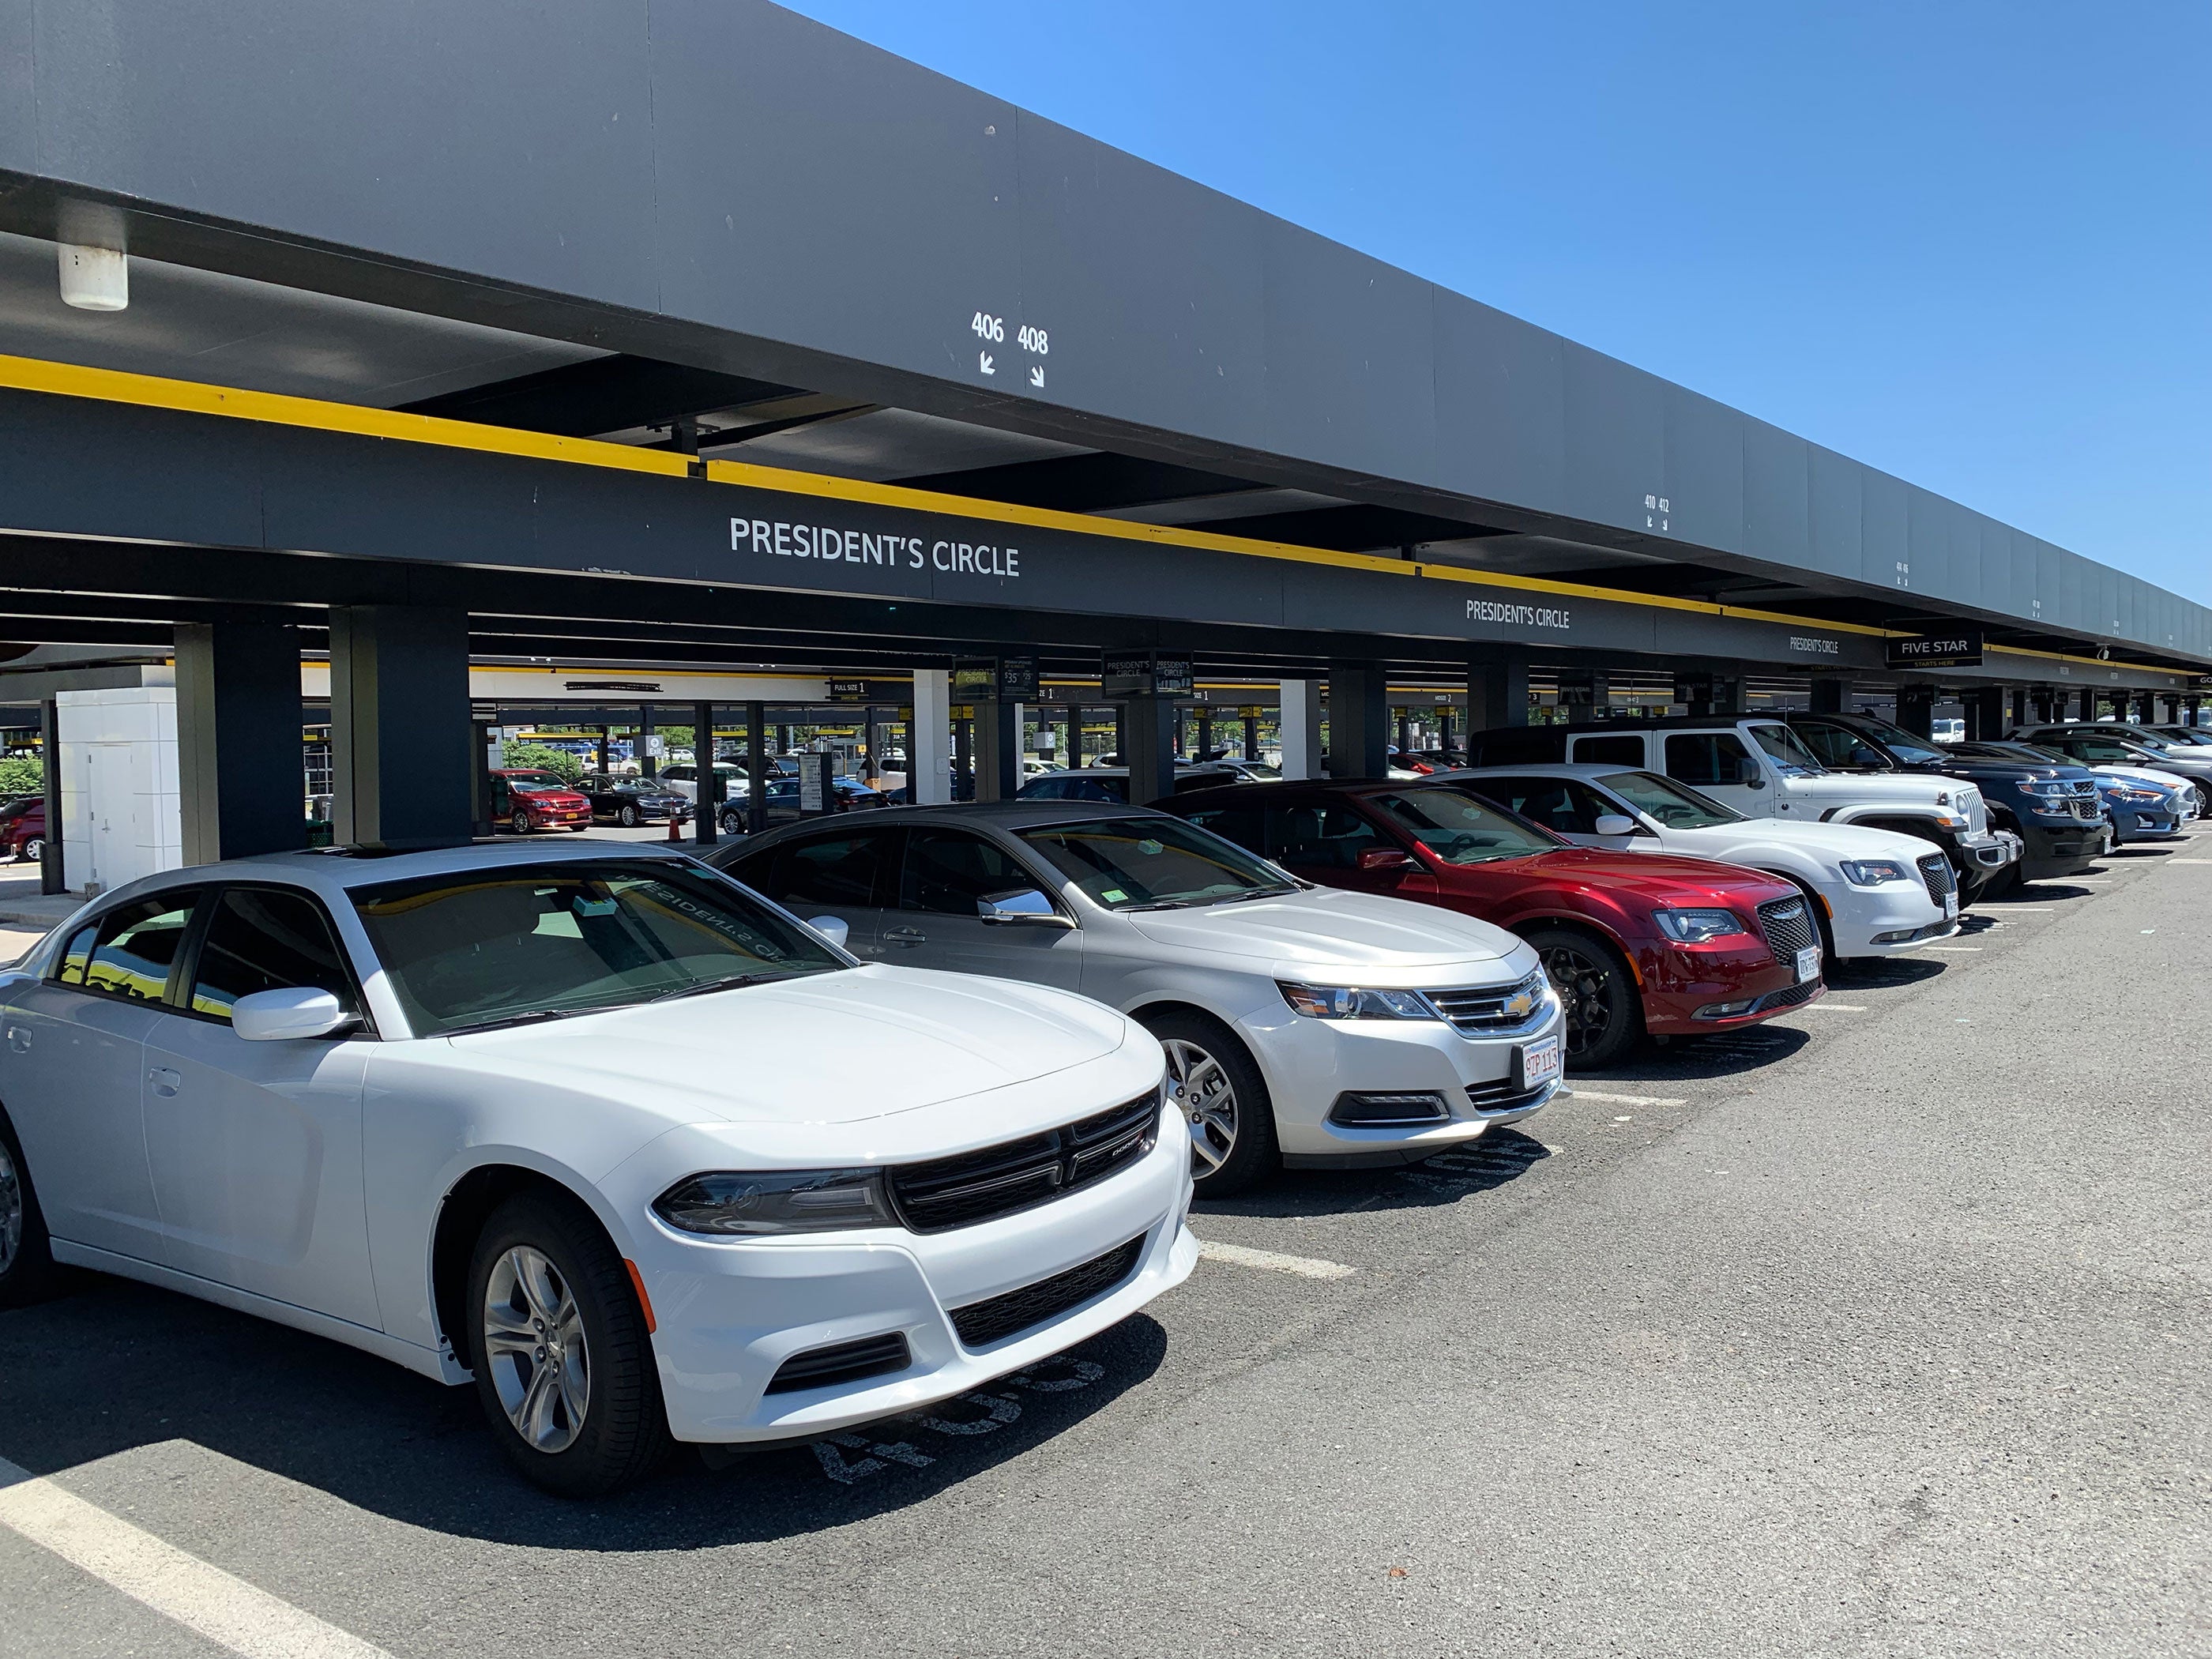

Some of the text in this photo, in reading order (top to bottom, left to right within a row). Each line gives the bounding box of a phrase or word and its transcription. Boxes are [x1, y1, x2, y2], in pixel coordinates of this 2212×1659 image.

[971, 311, 1048, 355] 406 408
[1645, 494, 1669, 513] 410 412
[730, 517, 1020, 577] PRESIDENT'S CIRCLE
[1466, 599, 1570, 629] PRESIDENT'S CIRCLE
[1790, 636, 1839, 654] PRESIDENT'S CIRCLE
[1902, 640, 1968, 654] FIVE STAR
[1108, 660, 1150, 670] PRESIDENT'S
[1157, 660, 1190, 670] PRESIDENT'S
[1116, 668, 1141, 677] CIRCLE
[1164, 668, 1183, 677] CIRCLE
[859, 682, 864, 693] 1
[1048, 688, 1054, 699] 1
[1204, 690, 1209, 701] 1
[1447, 694, 1452, 703] 2
[1542, 1046, 1558, 1072] 113
